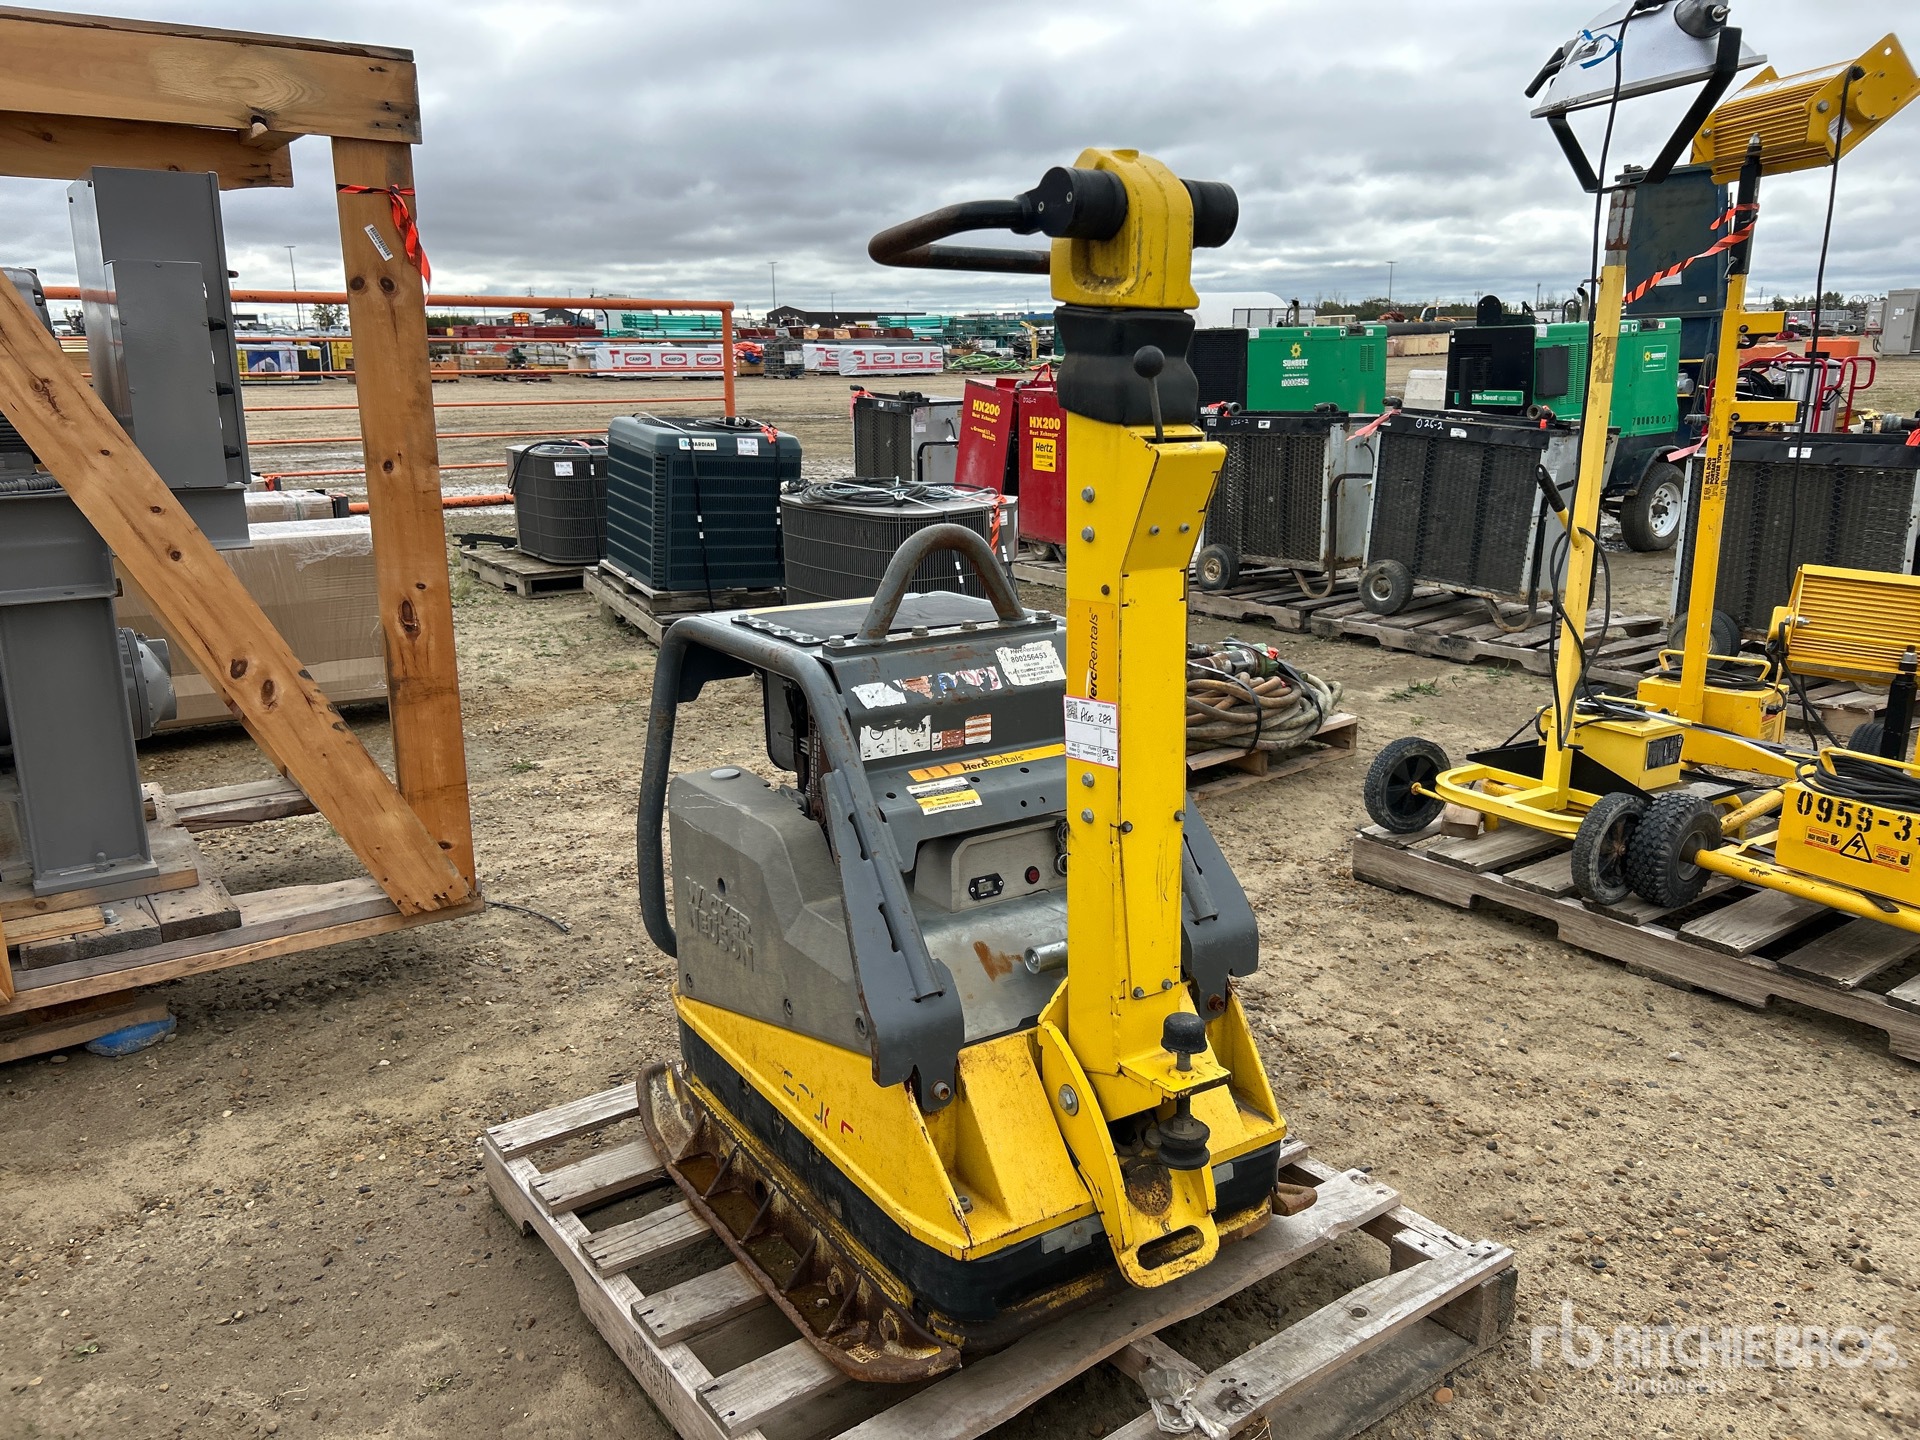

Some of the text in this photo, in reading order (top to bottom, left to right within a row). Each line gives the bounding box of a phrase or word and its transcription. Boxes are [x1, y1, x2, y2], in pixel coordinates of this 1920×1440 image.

[1282, 359, 1309, 367] SUNBELT
[972, 399, 1001, 417] HX200
[1029, 416, 1061, 431] HX200
[1035, 442, 1053, 453] Hertz
[1010, 652, 1048, 663] 800256453
[963, 754, 1025, 772] HercRentals
[685, 875, 752, 936] WACKER
[688, 902, 755, 972] NEUSON
